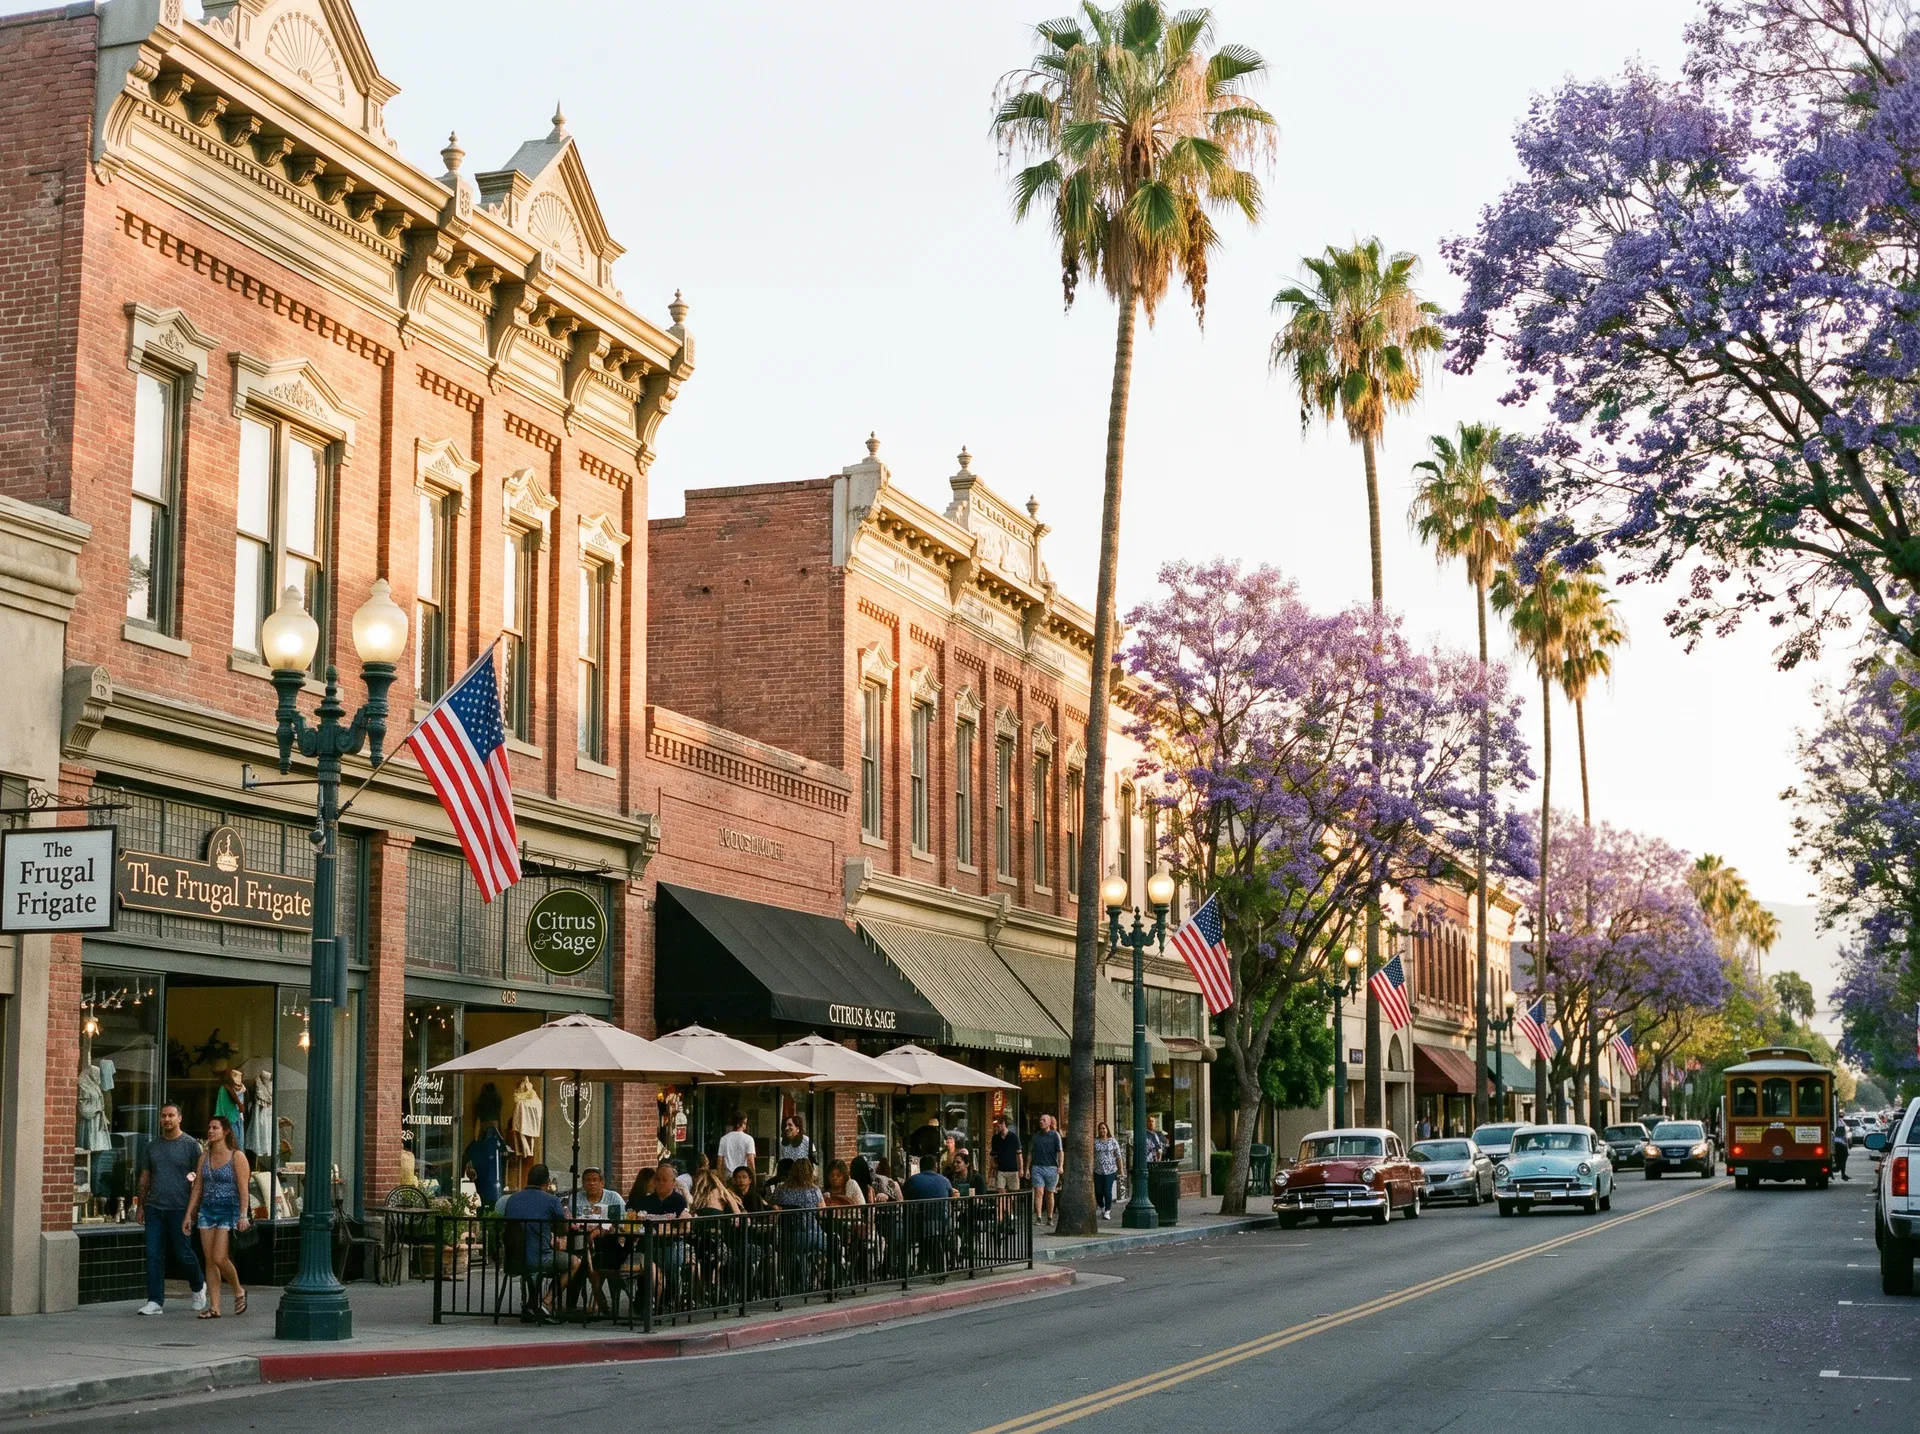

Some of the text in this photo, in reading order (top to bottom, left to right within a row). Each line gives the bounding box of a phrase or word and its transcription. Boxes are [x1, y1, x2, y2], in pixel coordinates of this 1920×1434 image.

[43, 841, 73, 858] The
[20, 858, 95, 890] Frugal
[127, 862, 312, 921] The Frugal Frigate
[16, 891, 97, 921] Frigate
[536, 912, 596, 930] Citrus
[533, 931, 596, 956] & Sage
[829, 1004, 896, 1029] CITRUS & SAGE
